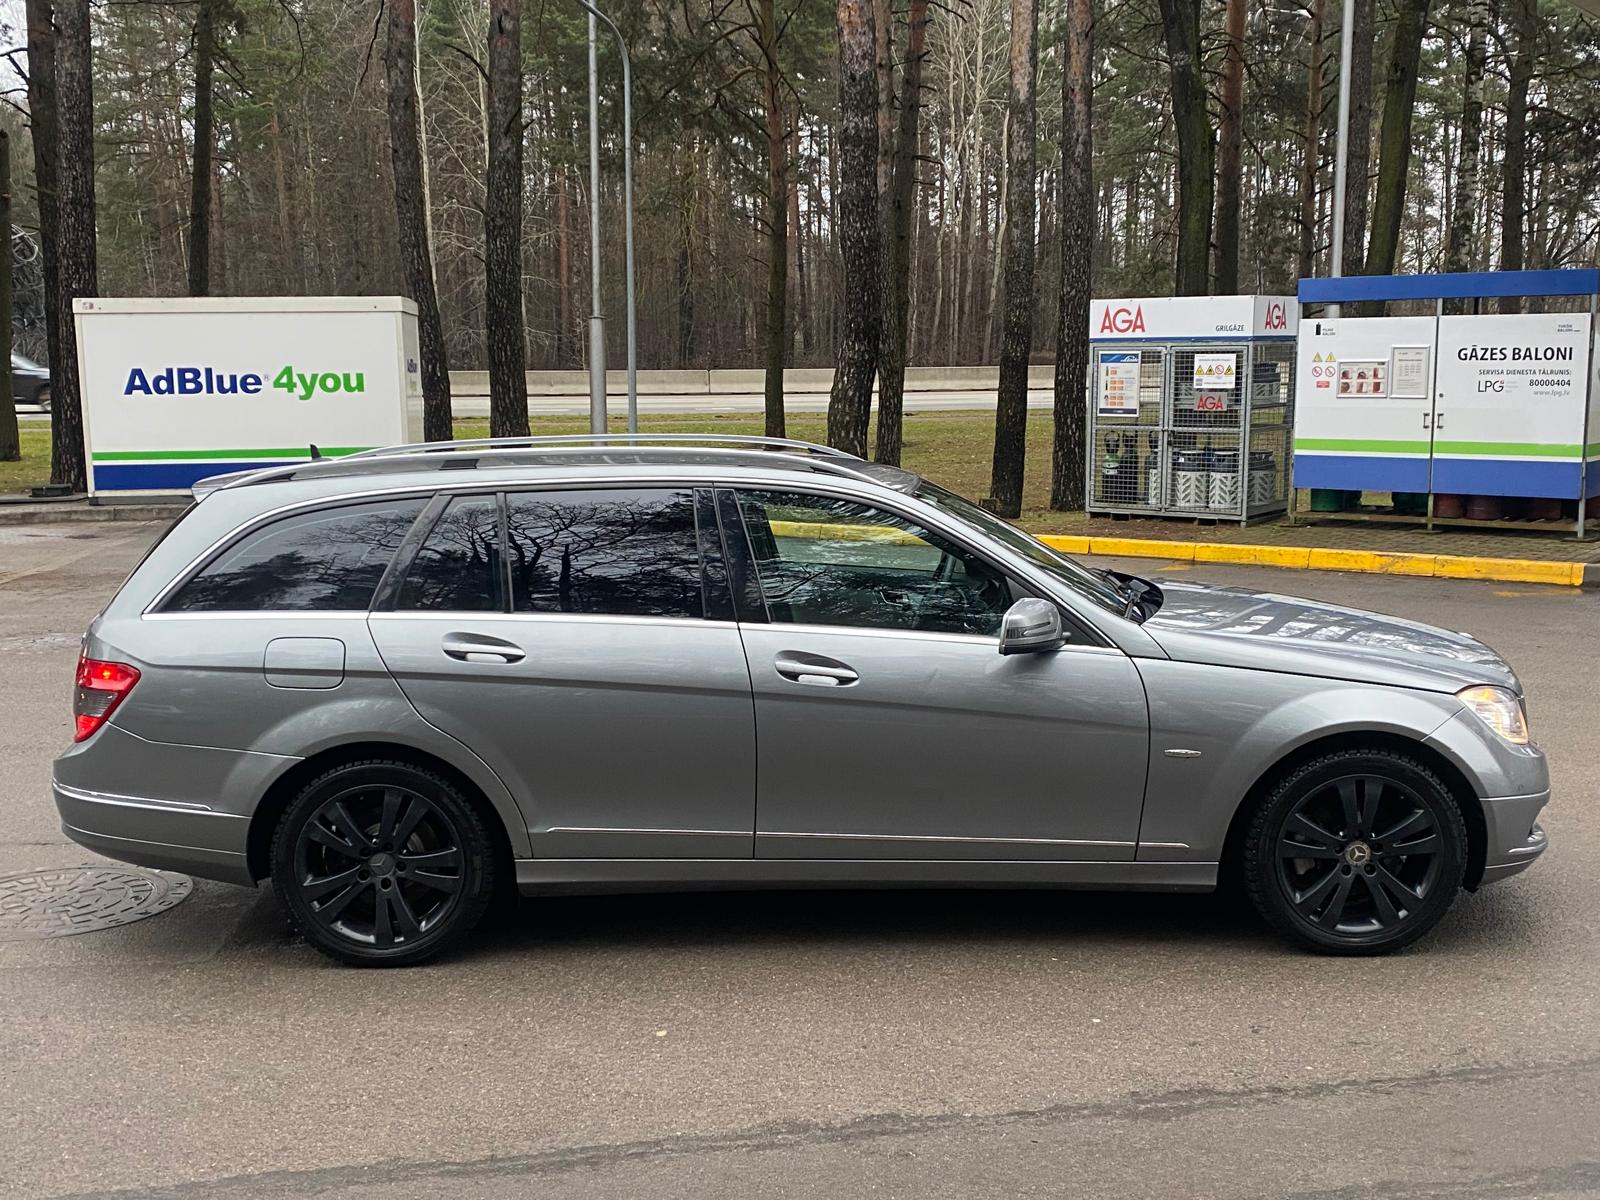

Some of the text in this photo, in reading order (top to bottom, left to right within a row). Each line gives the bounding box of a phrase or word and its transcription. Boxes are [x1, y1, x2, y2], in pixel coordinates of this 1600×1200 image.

[1100, 304, 1145, 333] AGA
[1265, 300, 1287, 329] AGA
[1457, 344, 1573, 361] GĀZES BALONI
[273, 365, 365, 400] 4you
[1477, 380, 1504, 393] LPG
[1529, 379, 1571, 387] 80000404
[1197, 394, 1224, 410] AGA
